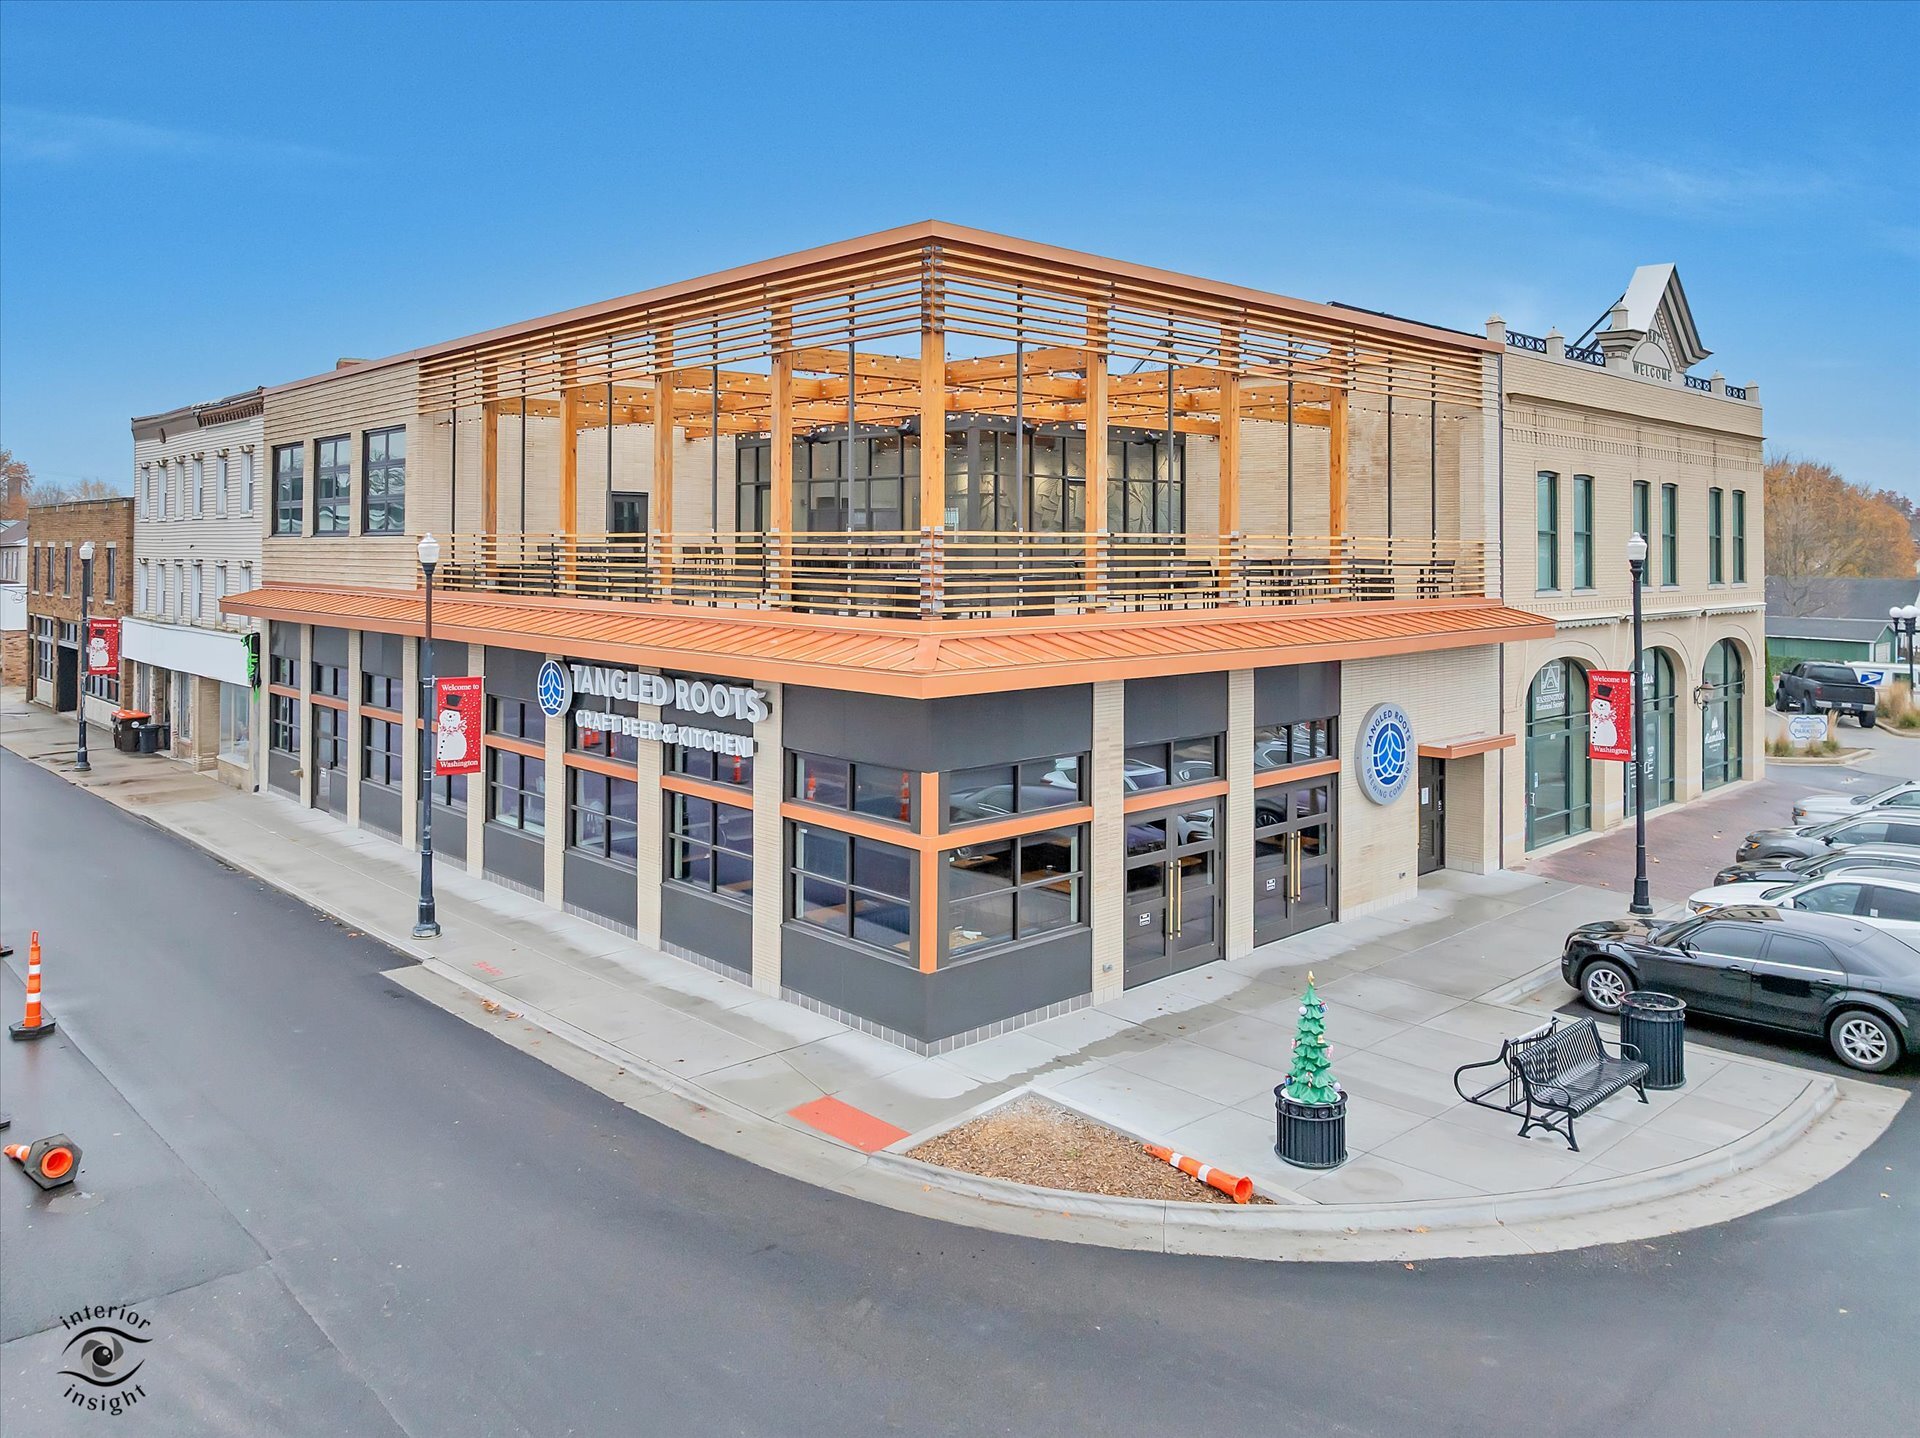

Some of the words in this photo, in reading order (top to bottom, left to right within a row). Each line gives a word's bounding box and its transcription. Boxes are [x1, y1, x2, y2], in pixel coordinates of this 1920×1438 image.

[1632, 361, 1672, 382] WELCOME
[441, 683, 472, 691] Welcome
[1592, 675, 1620, 683] Welcome
[570, 664, 675, 706] TANGLED
[675, 678, 769, 724] ROOTS
[575, 709, 624, 733] CRAFT
[622, 717, 663, 741] BEER
[662, 722, 679, 744] &
[678, 726, 754, 758] KITCHEN
[1366, 710, 1393, 748] TANGLED
[1394, 711, 1412, 742] ROOTS
[1593, 745, 1629, 755] Washington
[439, 760, 479, 768] Washington
[1366, 767, 1388, 799] BREWING
[1388, 761, 1411, 799] COMPANY
